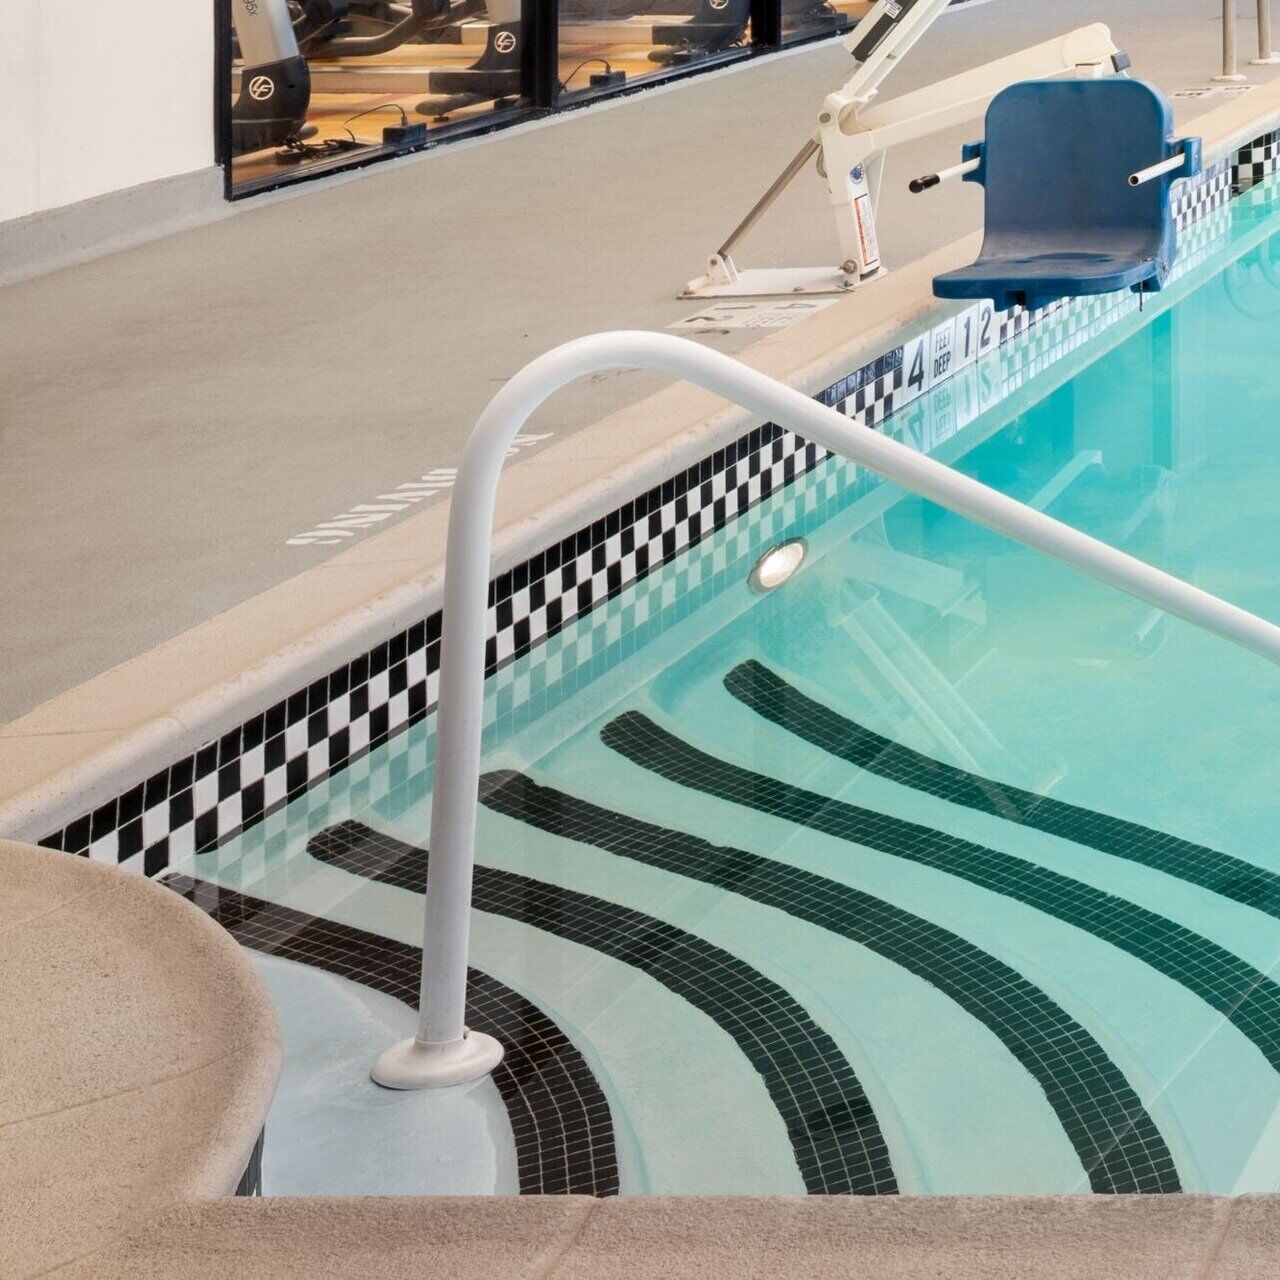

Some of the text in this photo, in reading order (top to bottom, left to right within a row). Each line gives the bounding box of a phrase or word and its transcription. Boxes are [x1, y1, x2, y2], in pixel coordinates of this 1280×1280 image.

[935, 327, 951, 353] FEET
[907, 338, 925, 392] 4
[933, 351, 951, 379] DEEP
